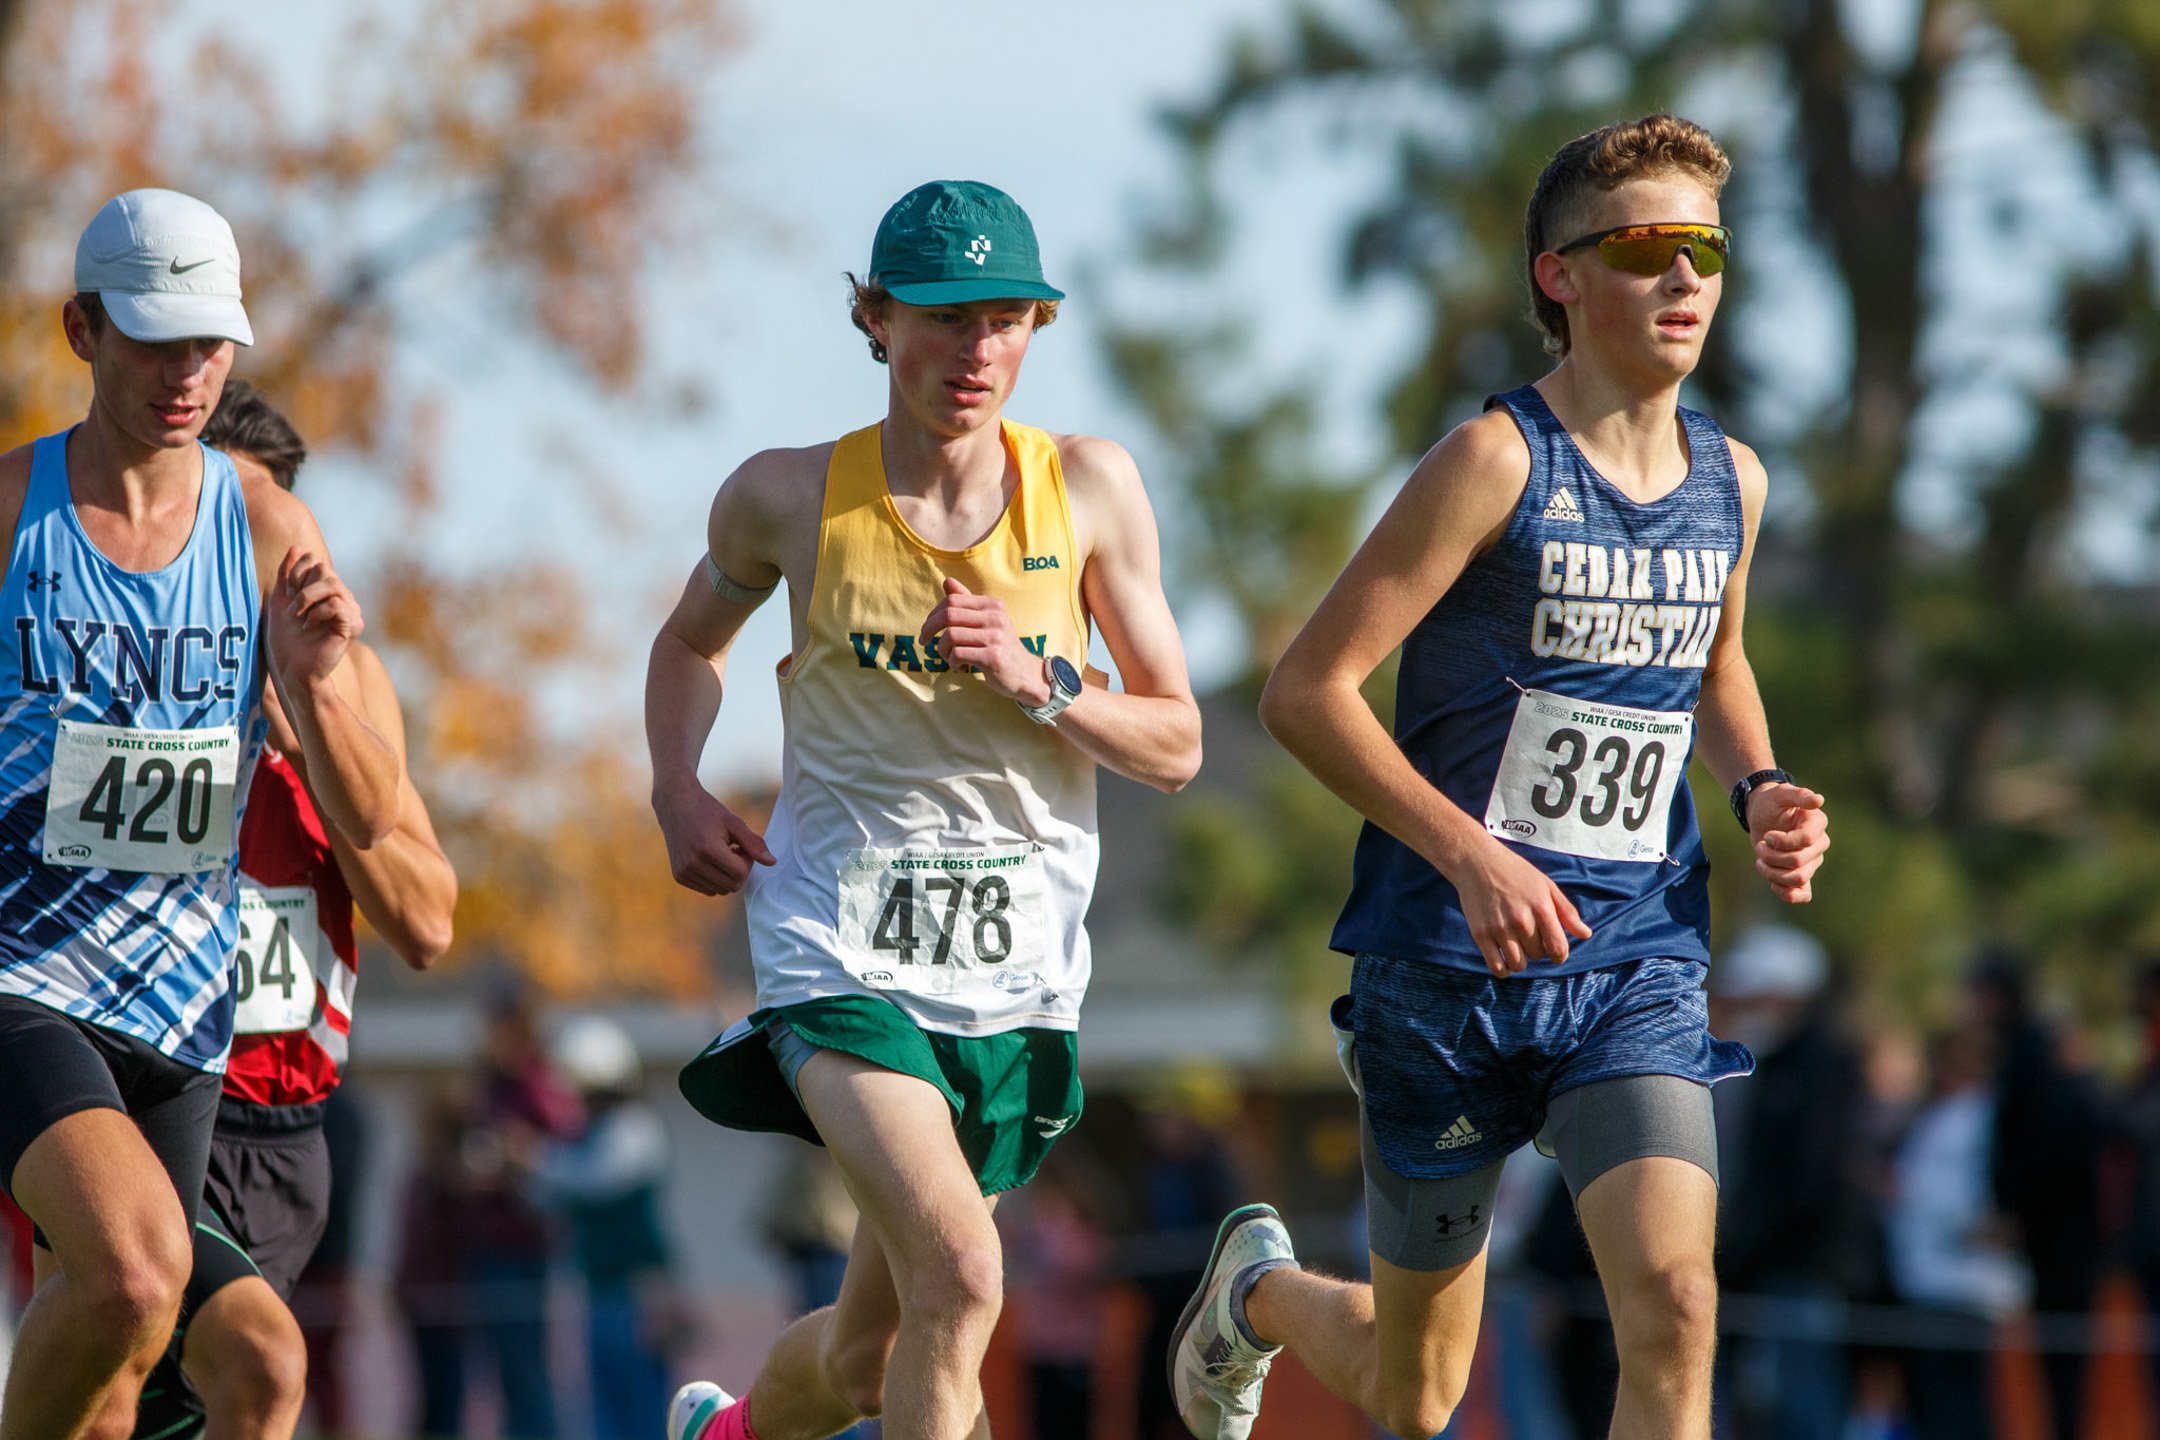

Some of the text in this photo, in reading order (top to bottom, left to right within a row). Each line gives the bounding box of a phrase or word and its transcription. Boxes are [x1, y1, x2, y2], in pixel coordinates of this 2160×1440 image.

[1543, 507, 1585, 522] adidas
[1539, 541, 1654, 600] CEDAR
[15, 616, 248, 704] LYNCS
[1534, 701, 1683, 735] 2025 STATE CROSS COUNTRY
[1589, 706, 1604, 715] WIAA
[1608, 709, 1622, 717] GESA
[1622, 711, 1641, 720] CREDIT
[107, 737, 144, 750] STATE
[148, 740, 185, 751] CROSS
[188, 738, 230, 751] COUNTRY
[1531, 728, 1665, 831] 339
[79, 755, 213, 845] 420
[891, 860, 930, 869] STATE
[933, 860, 974, 870] CROSS
[977, 855, 1026, 869] COUNTRY
[872, 875, 1013, 965] 478
[1434, 1131, 1482, 1149] adidas
